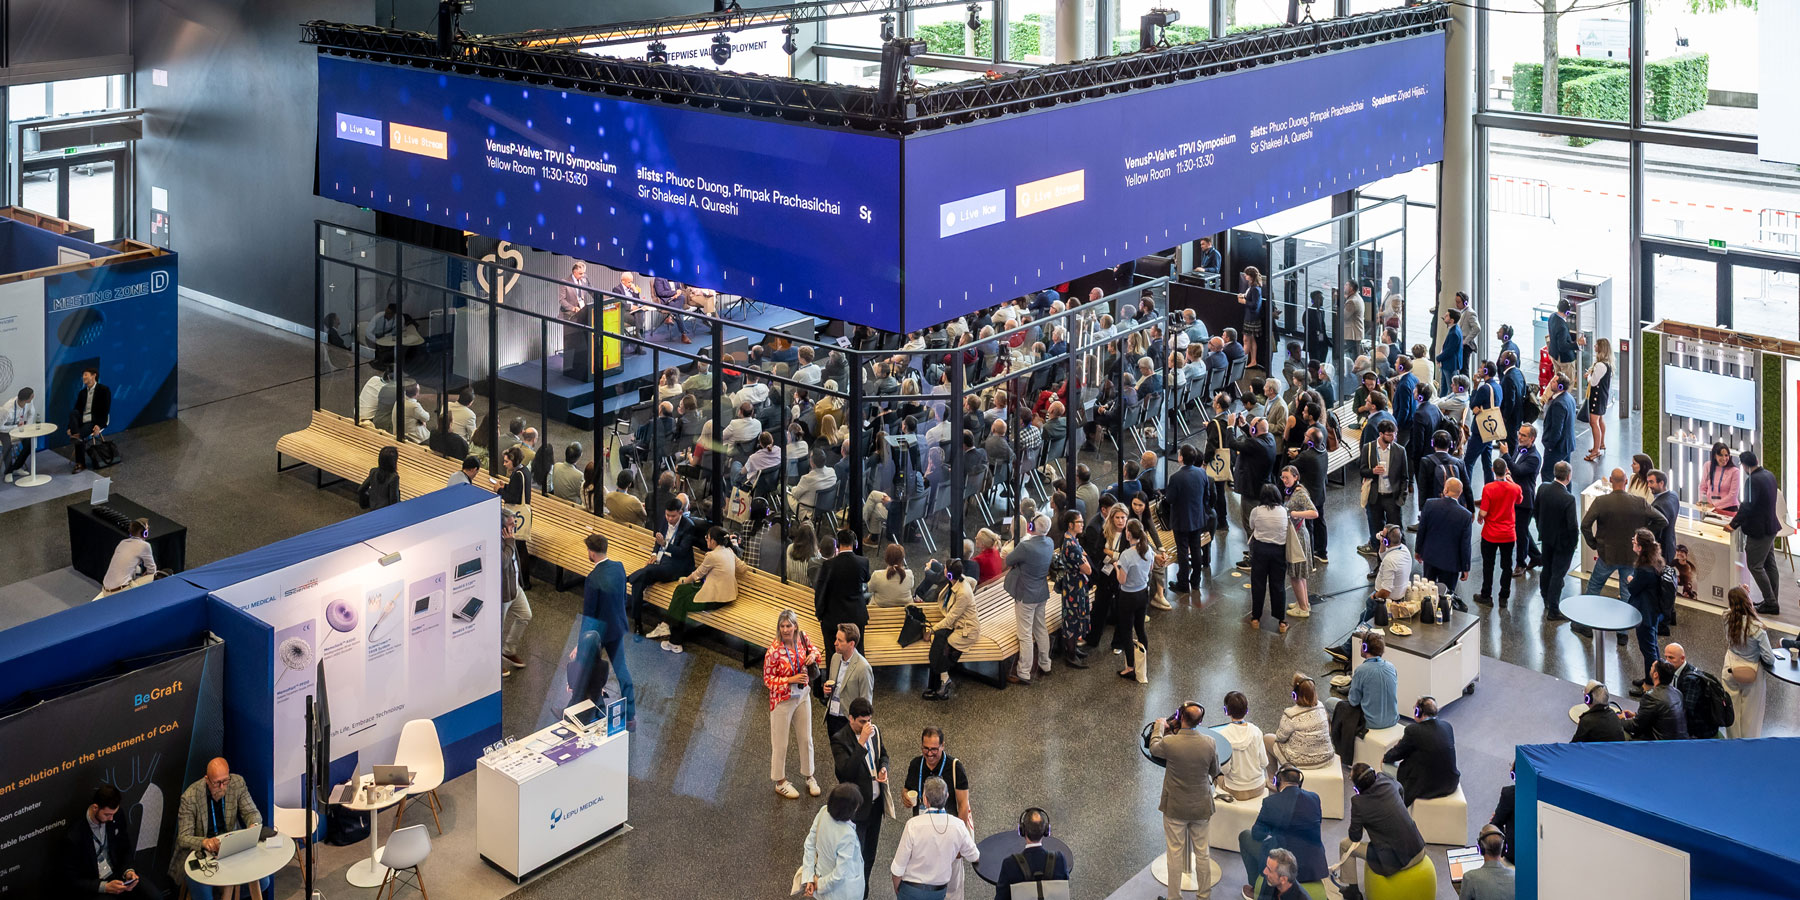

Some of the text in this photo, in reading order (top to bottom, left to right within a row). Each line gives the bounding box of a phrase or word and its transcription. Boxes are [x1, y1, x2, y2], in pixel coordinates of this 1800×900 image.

[667, 49, 698, 61] TEPWISE
[732, 41, 767, 53] PLOYMENT
[1269, 120, 1288, 133] Phuoc
[1288, 114, 1309, 127] Duong,
[1309, 109, 1330, 122] Pimpak
[1330, 99, 1365, 117] Prachasilchai
[1371, 92, 1397, 108] Speakers:
[1397, 89, 1411, 101] Ziyad
[349, 124, 376, 136] Live Now
[404, 134, 443, 150] Live Stream
[1250, 127, 1314, 154] Sir Shakeel A. Qureshi
[486, 138, 617, 174] VenusP-Valve: TPVI Symposium
[1124, 133, 1237, 170] VenusP-Valve: TPVI Symposium
[486, 155, 588, 186] Yellow Room 11:30-13:30
[1124, 153, 1215, 188] Yellow Room 11:30-13:30
[637, 185, 739, 216] Sir Shakeel A. Qureshi
[665, 171, 695, 189] Phuoc
[697, 177, 732, 198] Duong,
[733, 183, 771, 203] Pimpak
[773, 190, 841, 215] Prachasilchai
[960, 204, 997, 222] Live Now
[53, 270, 169, 311] MEETING ZONE D
[250, 595, 277, 609] MEDICAL
[134, 680, 183, 706] BeGraft
[351, 716, 375, 729] Embrace
[375, 703, 406, 720] Technology
[18, 766, 60, 788] solution
[61, 758, 77, 772] for
[78, 751, 96, 767] the
[97, 732, 145, 759] treatment
[147, 727, 158, 739] of
[159, 720, 179, 735] CoA
[14, 801, 42, 817] catheter
[563, 796, 604, 820] LEPU MEDICAL
[19, 818, 66, 842] foreshortening
